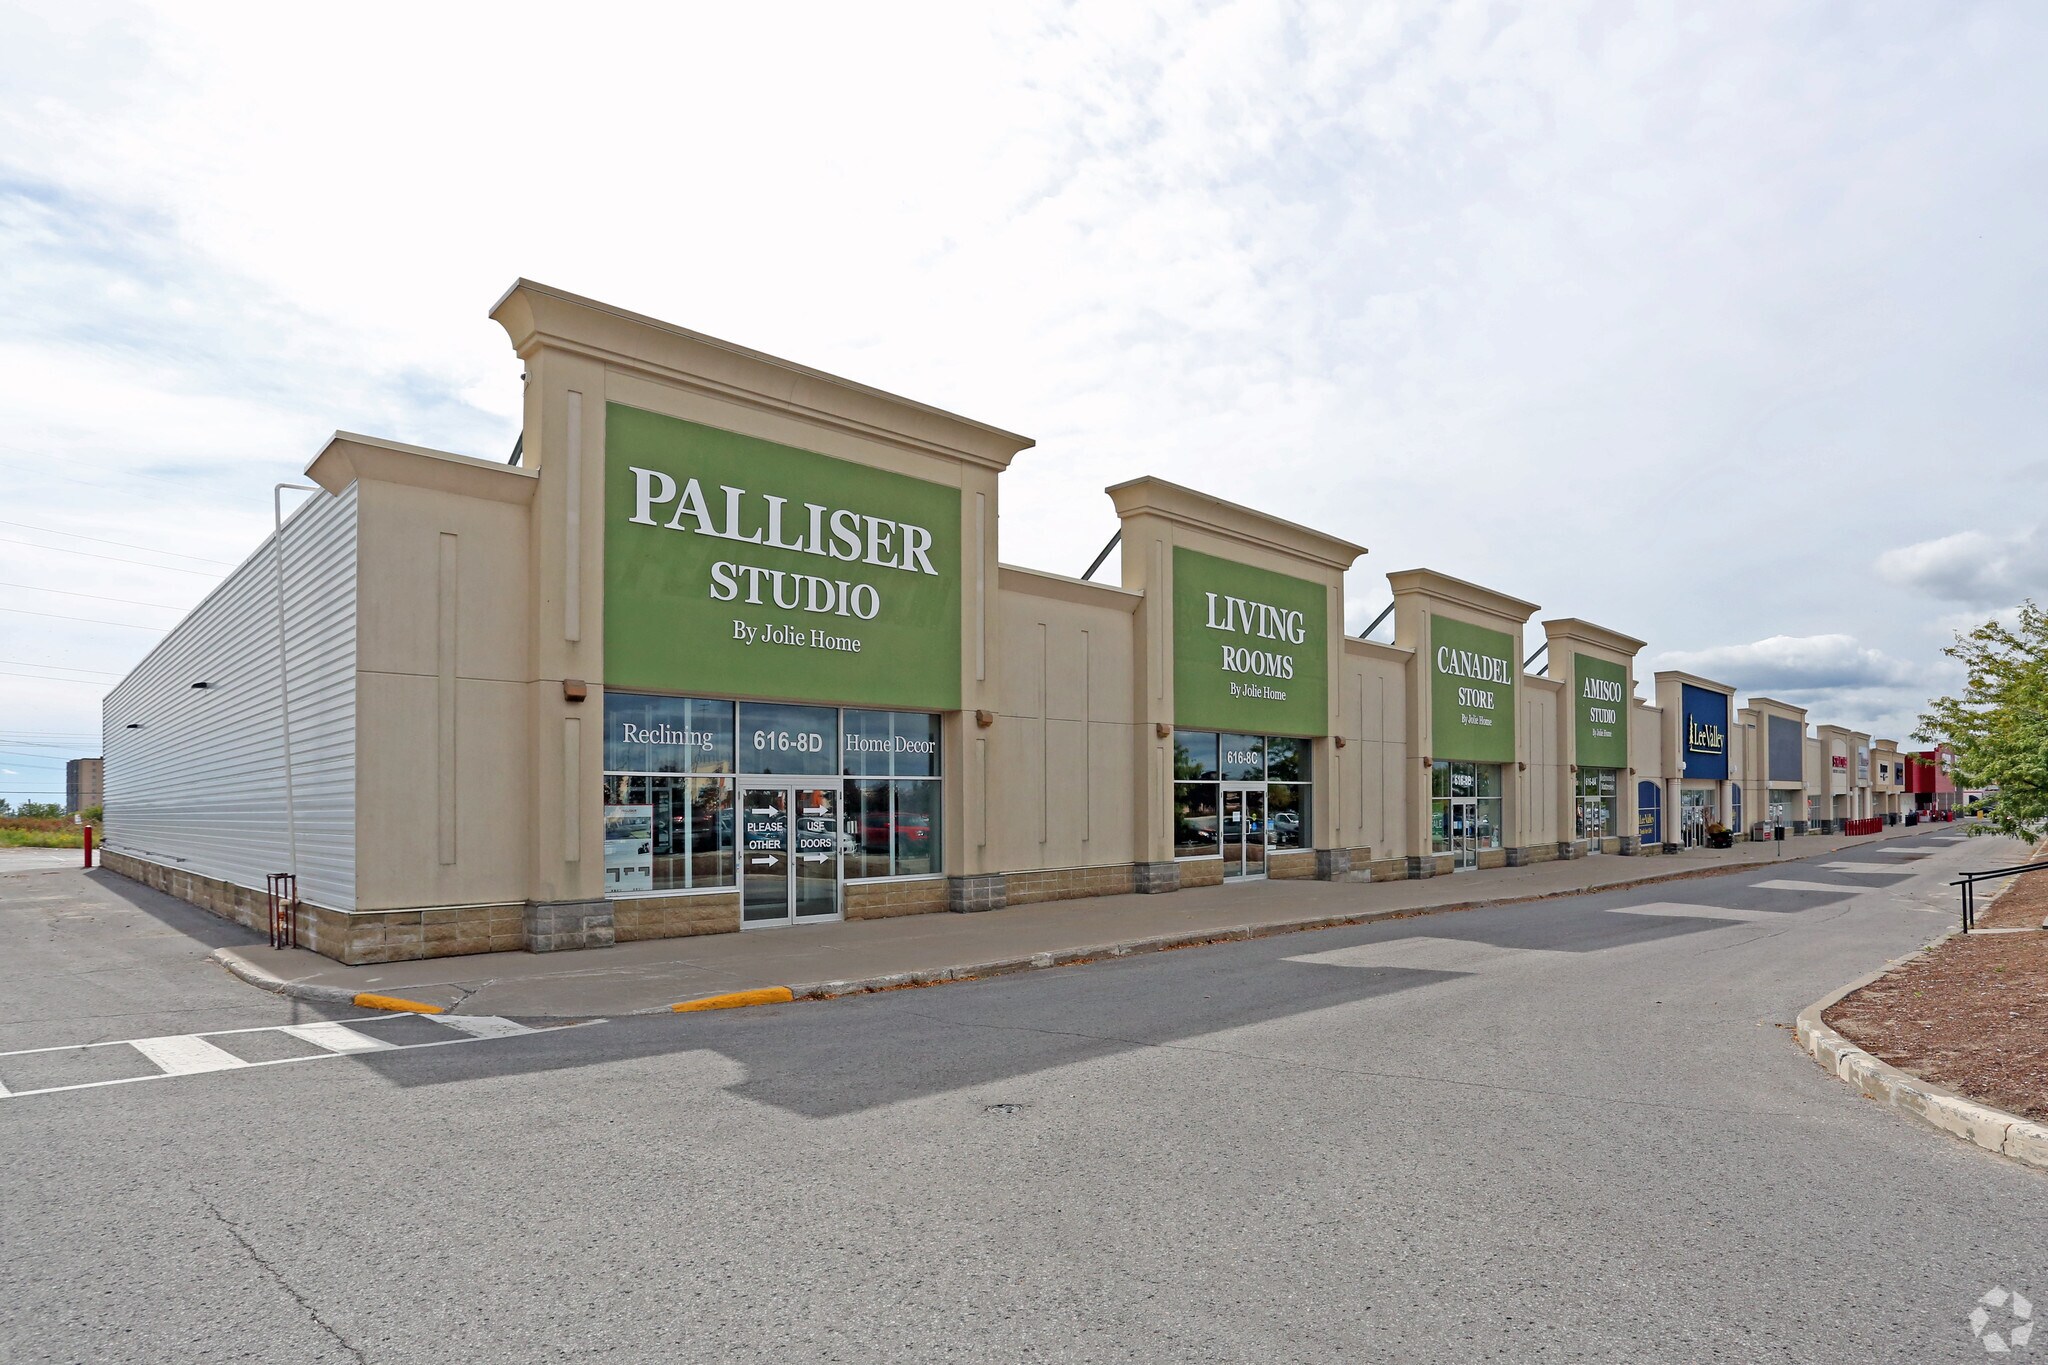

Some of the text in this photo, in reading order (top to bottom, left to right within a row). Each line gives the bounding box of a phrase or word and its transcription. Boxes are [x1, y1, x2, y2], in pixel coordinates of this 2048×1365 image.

[628, 466, 939, 576] PALLISER
[709, 560, 881, 620] STUDIO
[1205, 591, 1306, 645] LIVING
[732, 620, 862, 653] By Jolie Home
[1221, 645, 1294, 680] ROOMS
[1437, 645, 1512, 685] CANADEL
[1229, 681, 1287, 701] By Jolie Home
[1458, 686, 1495, 710] STORE
[1582, 676, 1622, 703] AMISCO
[1590, 706, 1616, 724] STUDIO
[622, 722, 714, 751] Reclining
[753, 730, 823, 753] 616-8D
[845, 733, 936, 755] Home Decor
[1226, 750, 1258, 765] 616-8C
[747, 821, 825, 833] PLEASE USE
[749, 838, 832, 850] OTHER DOORS
